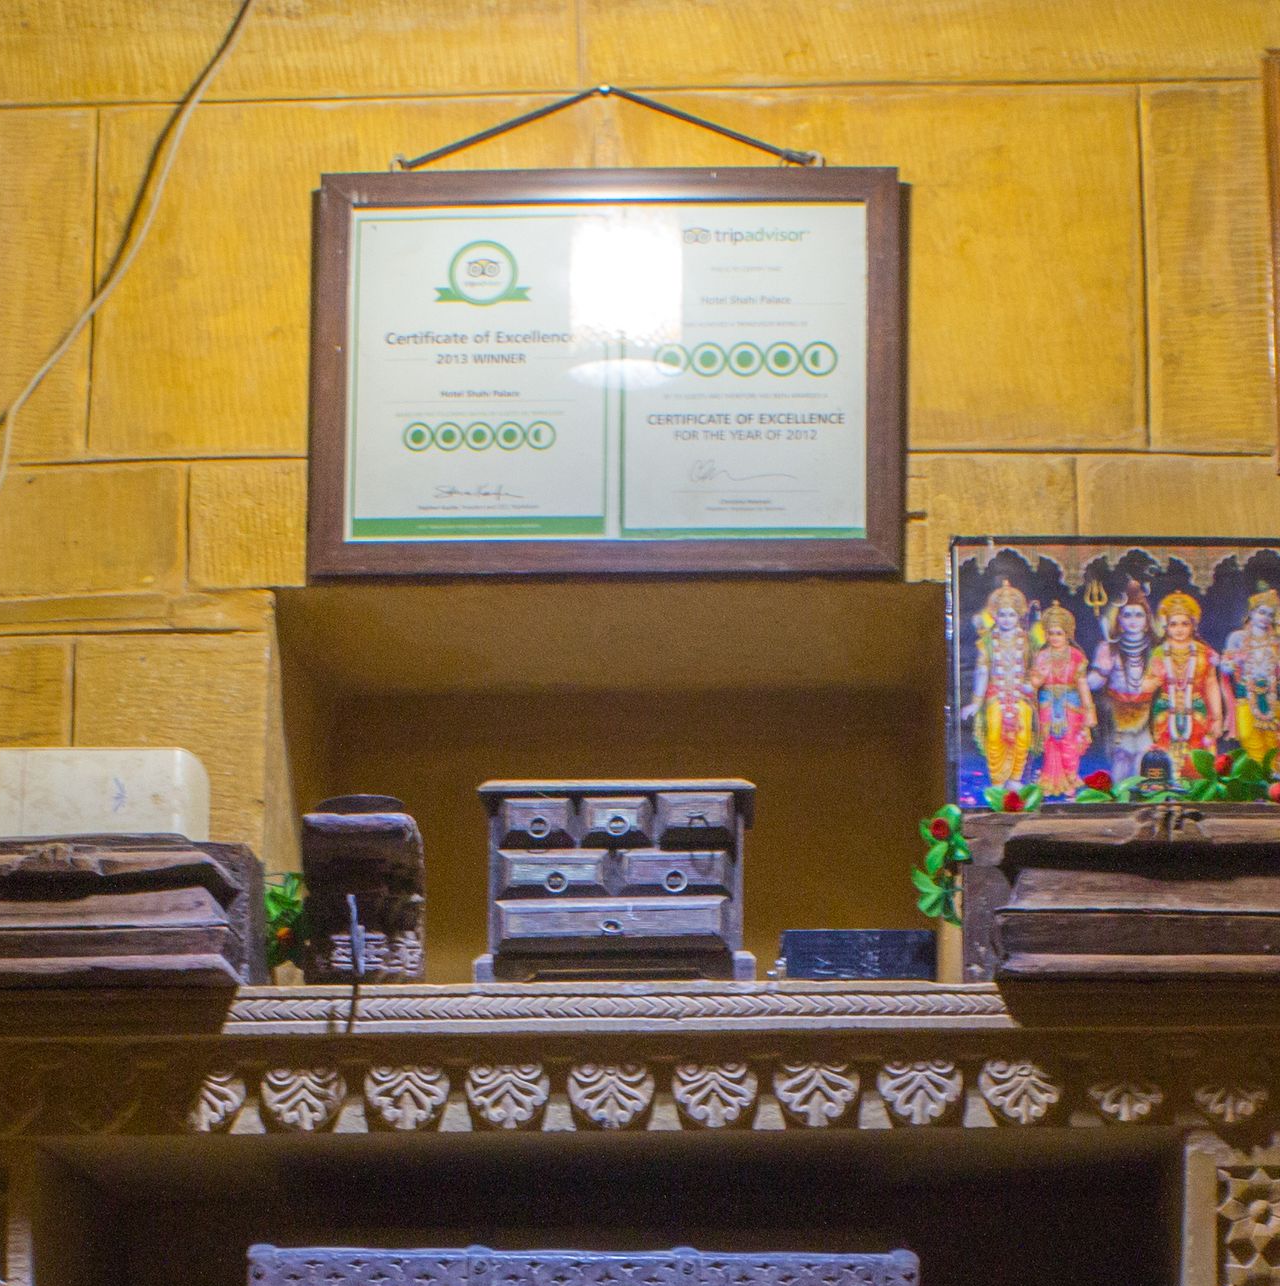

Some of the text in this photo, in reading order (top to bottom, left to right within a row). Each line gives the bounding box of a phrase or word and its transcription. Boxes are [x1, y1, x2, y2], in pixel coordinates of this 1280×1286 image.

[714, 227, 805, 244] tripadvisor
[385, 331, 469, 345] Certificate
[473, 331, 490, 344] of
[436, 353, 527, 365] 2013 WINNER
[647, 413, 845, 425] CERTIFICATE OF EXCELLENCE
[674, 430, 817, 441] FOR THE YEAR OF 2012
